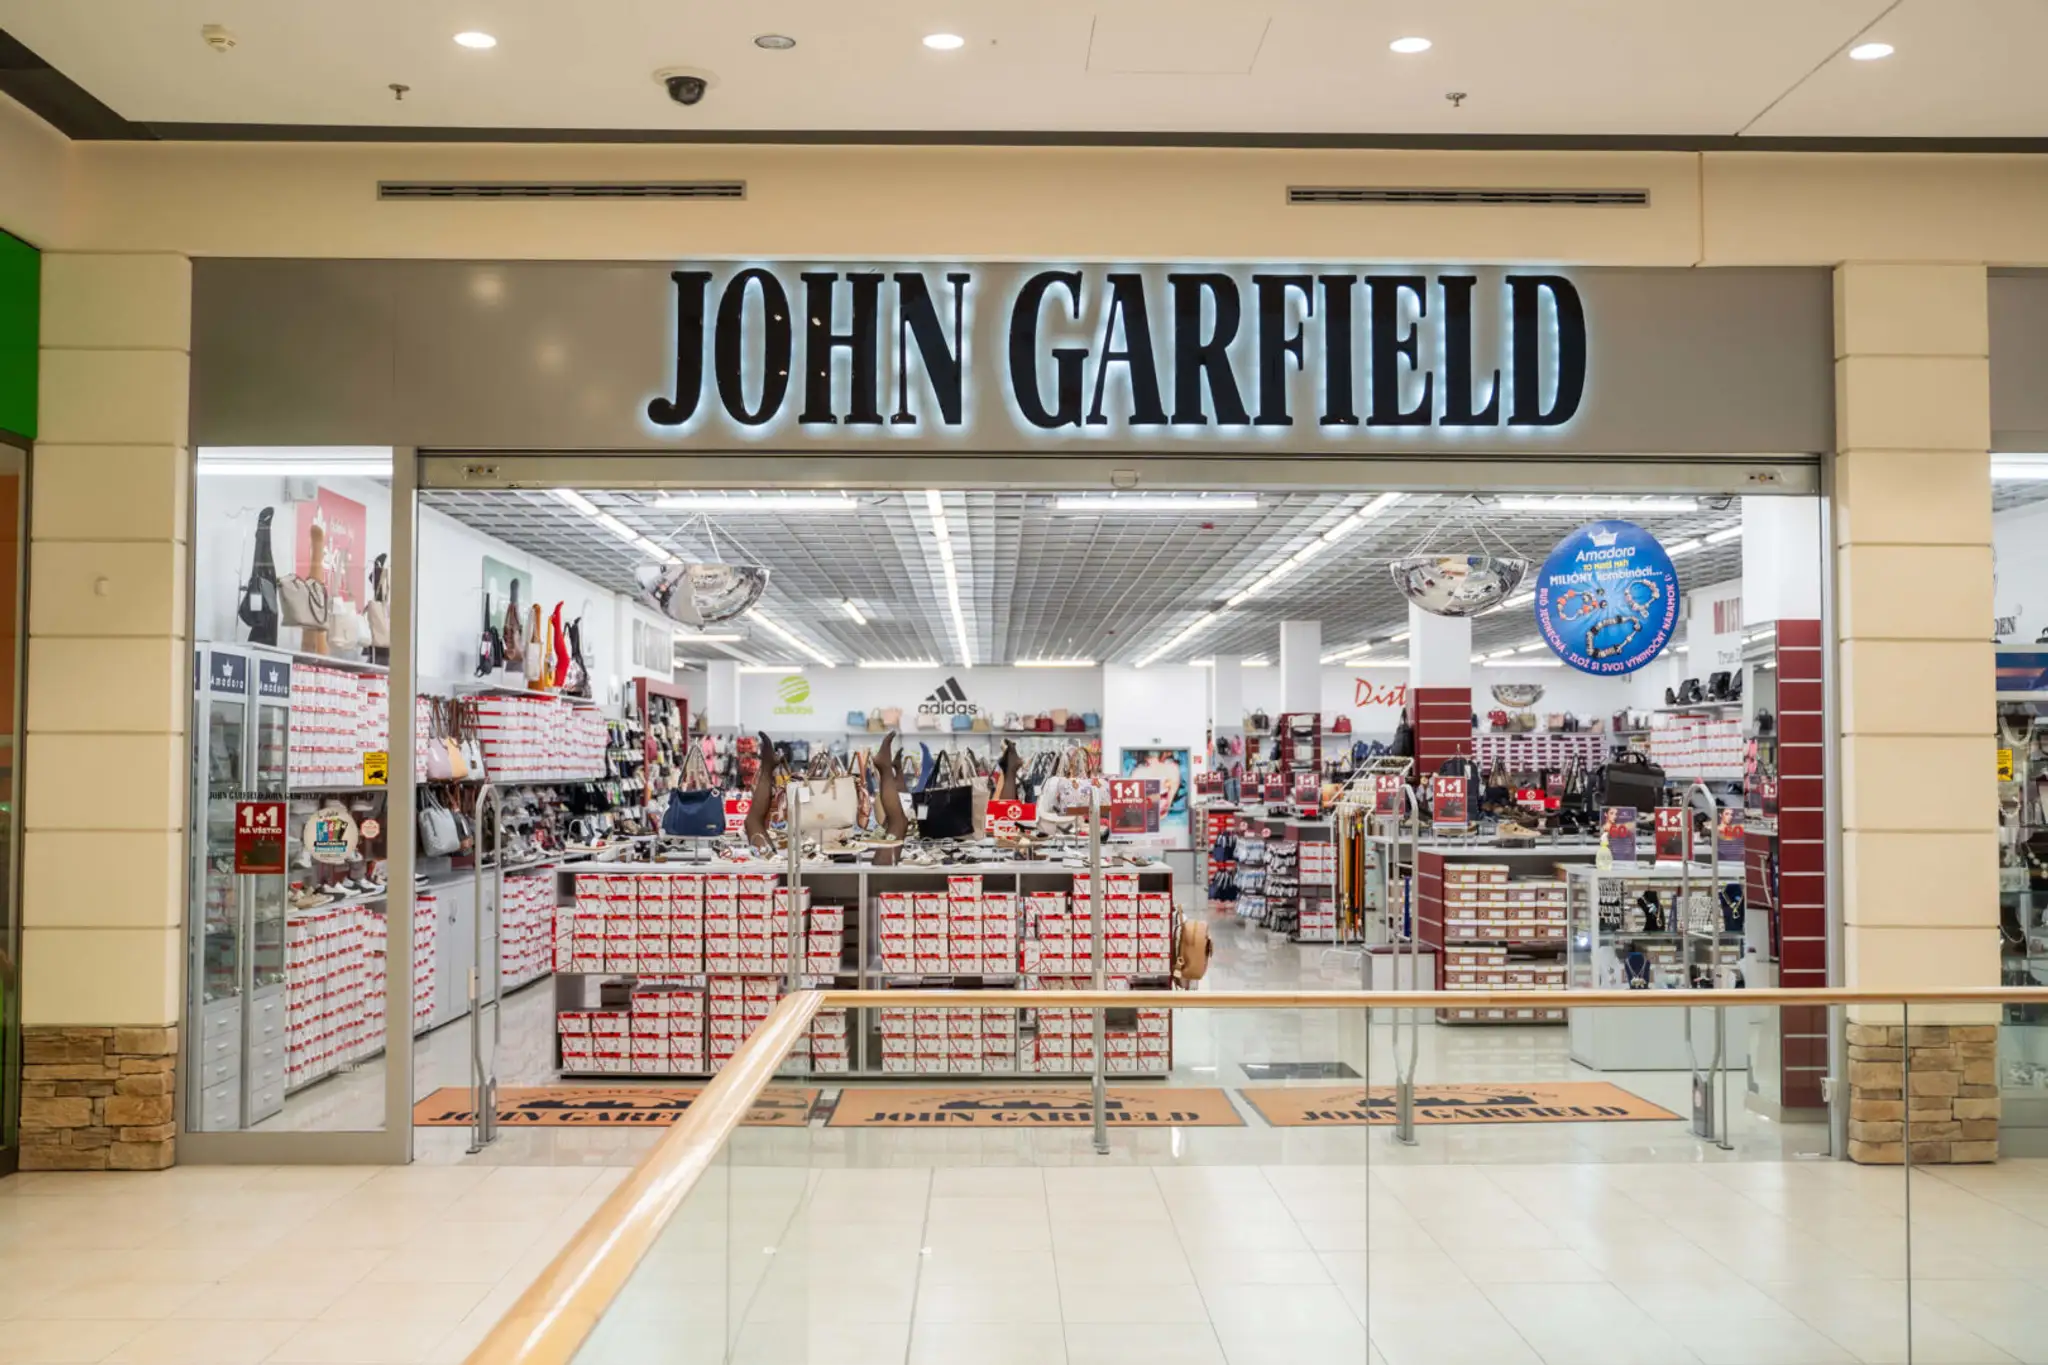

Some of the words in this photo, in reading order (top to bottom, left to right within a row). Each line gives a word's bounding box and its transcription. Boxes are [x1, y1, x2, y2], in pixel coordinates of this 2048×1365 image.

[647, 267, 971, 428] JOHN
[1009, 269, 1588, 430] GARFIELD
[1575, 546, 1636, 562] Amadora
[1549, 570, 1593, 587] MILIÓNY
[1591, 661, 1600, 671] SI
[1601, 661, 1625, 672] SVOJ
[210, 675, 245, 690] Amadora
[773, 704, 813, 715] adidas
[918, 700, 978, 715] adidas
[1379, 775, 1400, 786] 1+1
[1437, 778, 1462, 793] 1+1
[1114, 781, 1140, 798] 1+1
[241, 805, 279, 828] 1+1
[252, 825, 282, 835] VŠETKO
[865, 1111, 976, 1123] JOHN
[1420, 1106, 1630, 1120] GARFIELD
